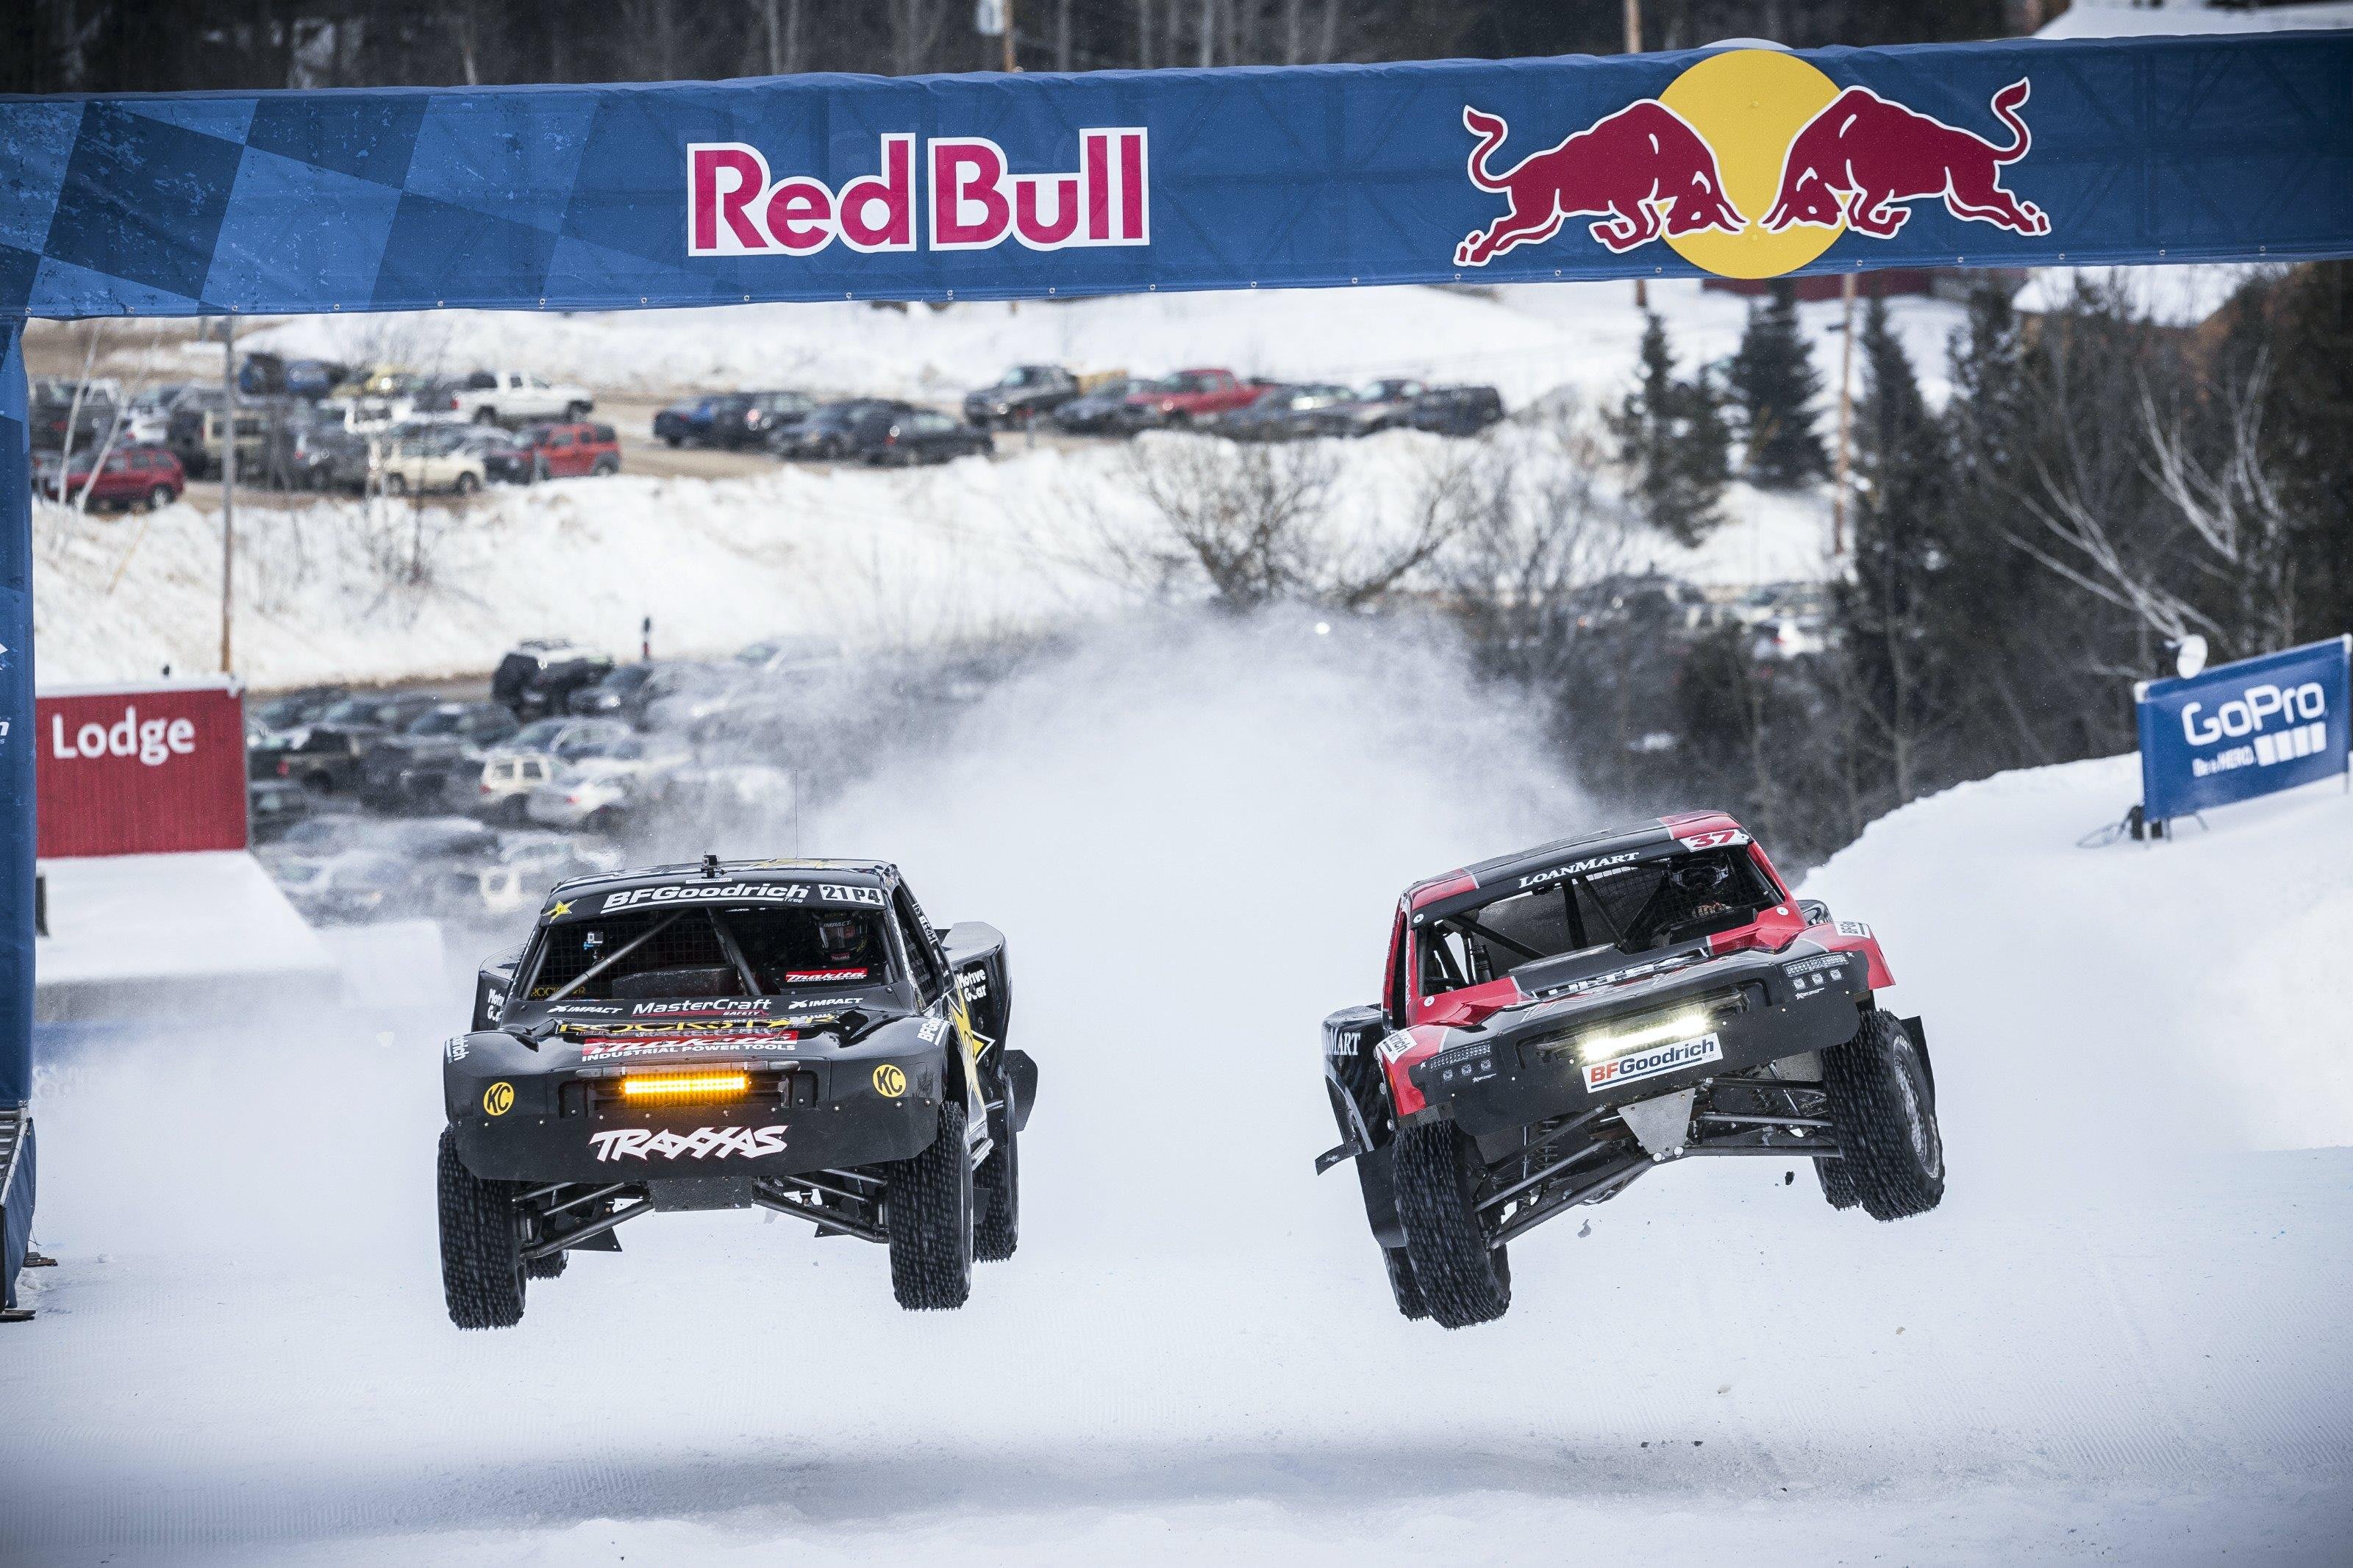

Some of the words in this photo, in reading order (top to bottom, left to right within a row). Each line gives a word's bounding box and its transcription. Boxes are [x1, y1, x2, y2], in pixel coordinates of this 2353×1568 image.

[689, 134, 915, 255] Red
[929, 129, 1149, 250] Bull
[2181, 682, 2325, 745] GoPro
[52, 705, 196, 766] Lodge
[1689, 831, 1736, 847] 37
[603, 884, 810, 909] BFGoodrich
[822, 886, 849, 900] 21
[632, 999, 771, 1015] MasterCraft
[582, 1048, 679, 1062] INDUSTRIAL
[1590, 1039, 1714, 1083] BFGoodrich
[878, 1068, 903, 1095] KC
[487, 1084, 513, 1113] KC
[589, 1125, 789, 1162] TRAXXAS
